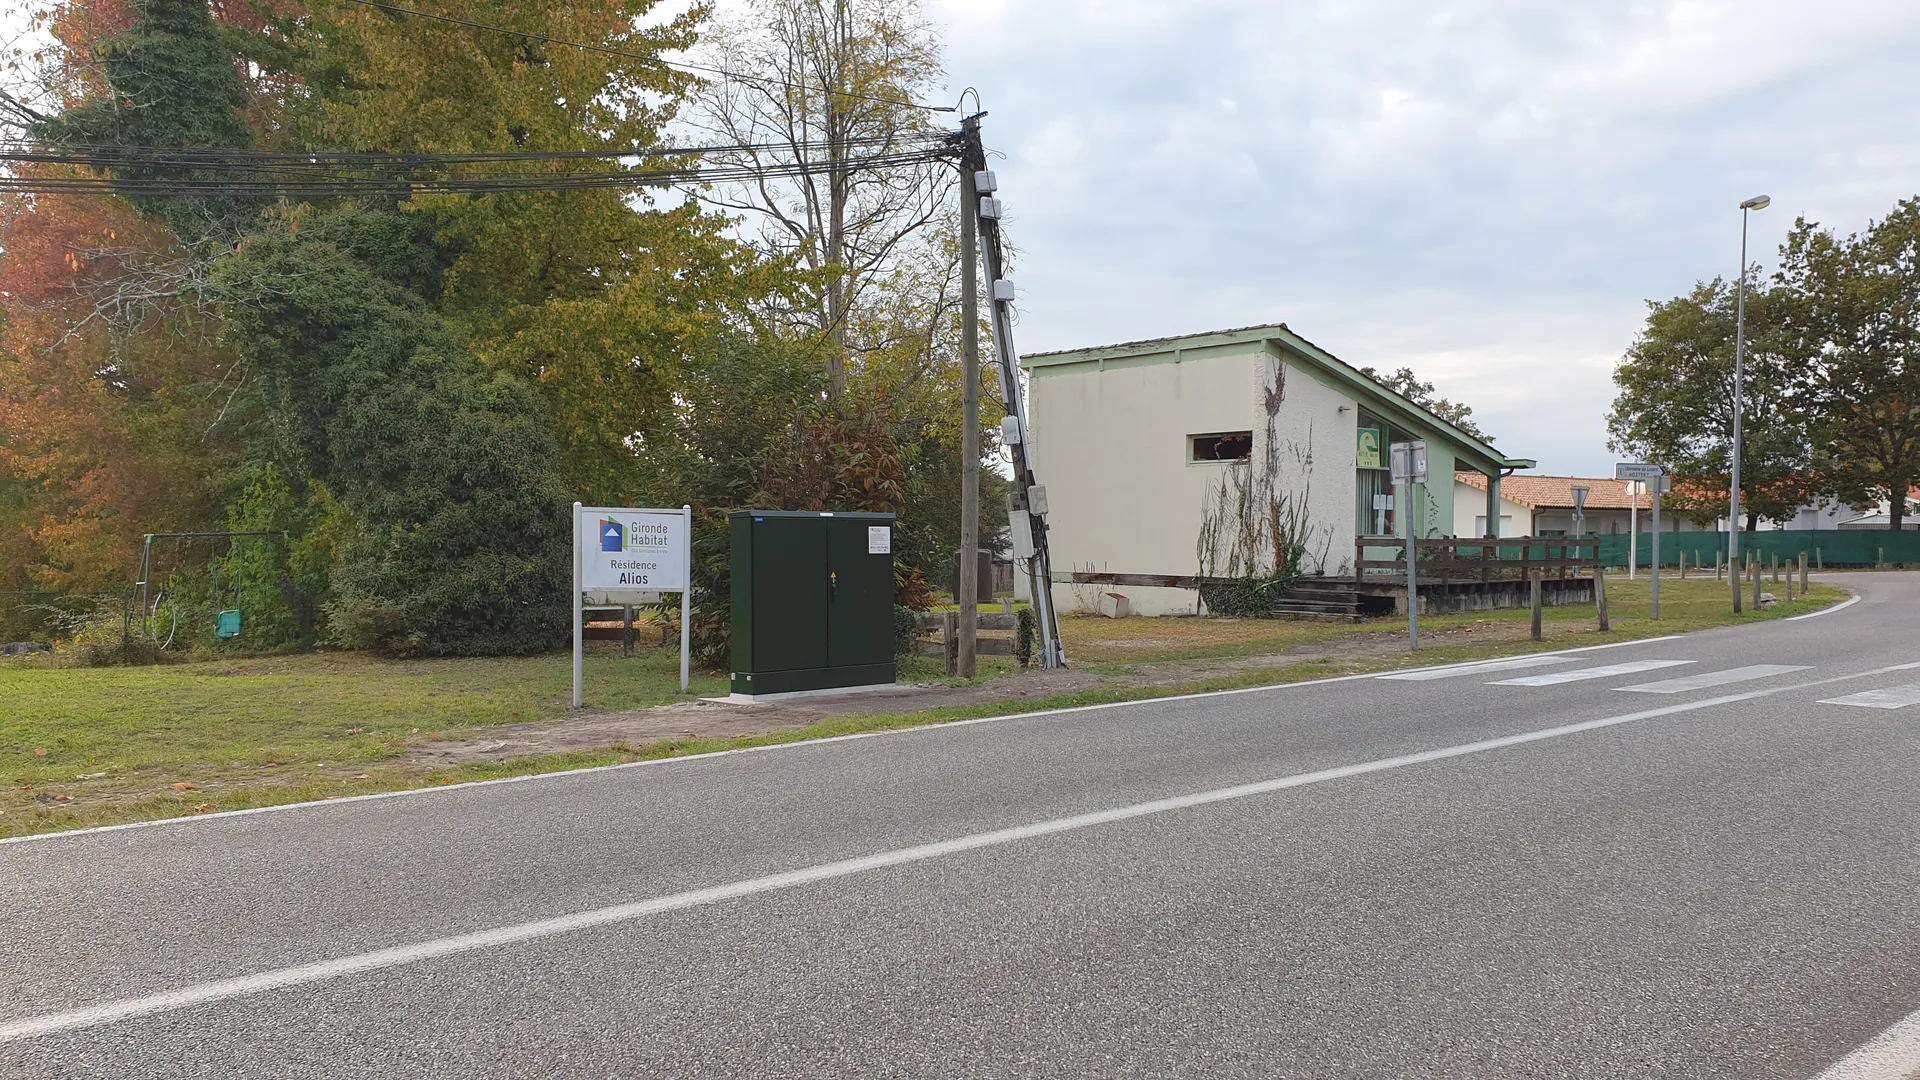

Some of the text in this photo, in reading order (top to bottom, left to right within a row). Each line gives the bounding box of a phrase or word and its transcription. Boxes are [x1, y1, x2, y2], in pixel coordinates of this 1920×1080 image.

[631, 522, 668, 534] Gironde
[631, 534, 668, 546] Habitat
[611, 560, 657, 570] Résidence
[619, 572, 648, 585] Alios
